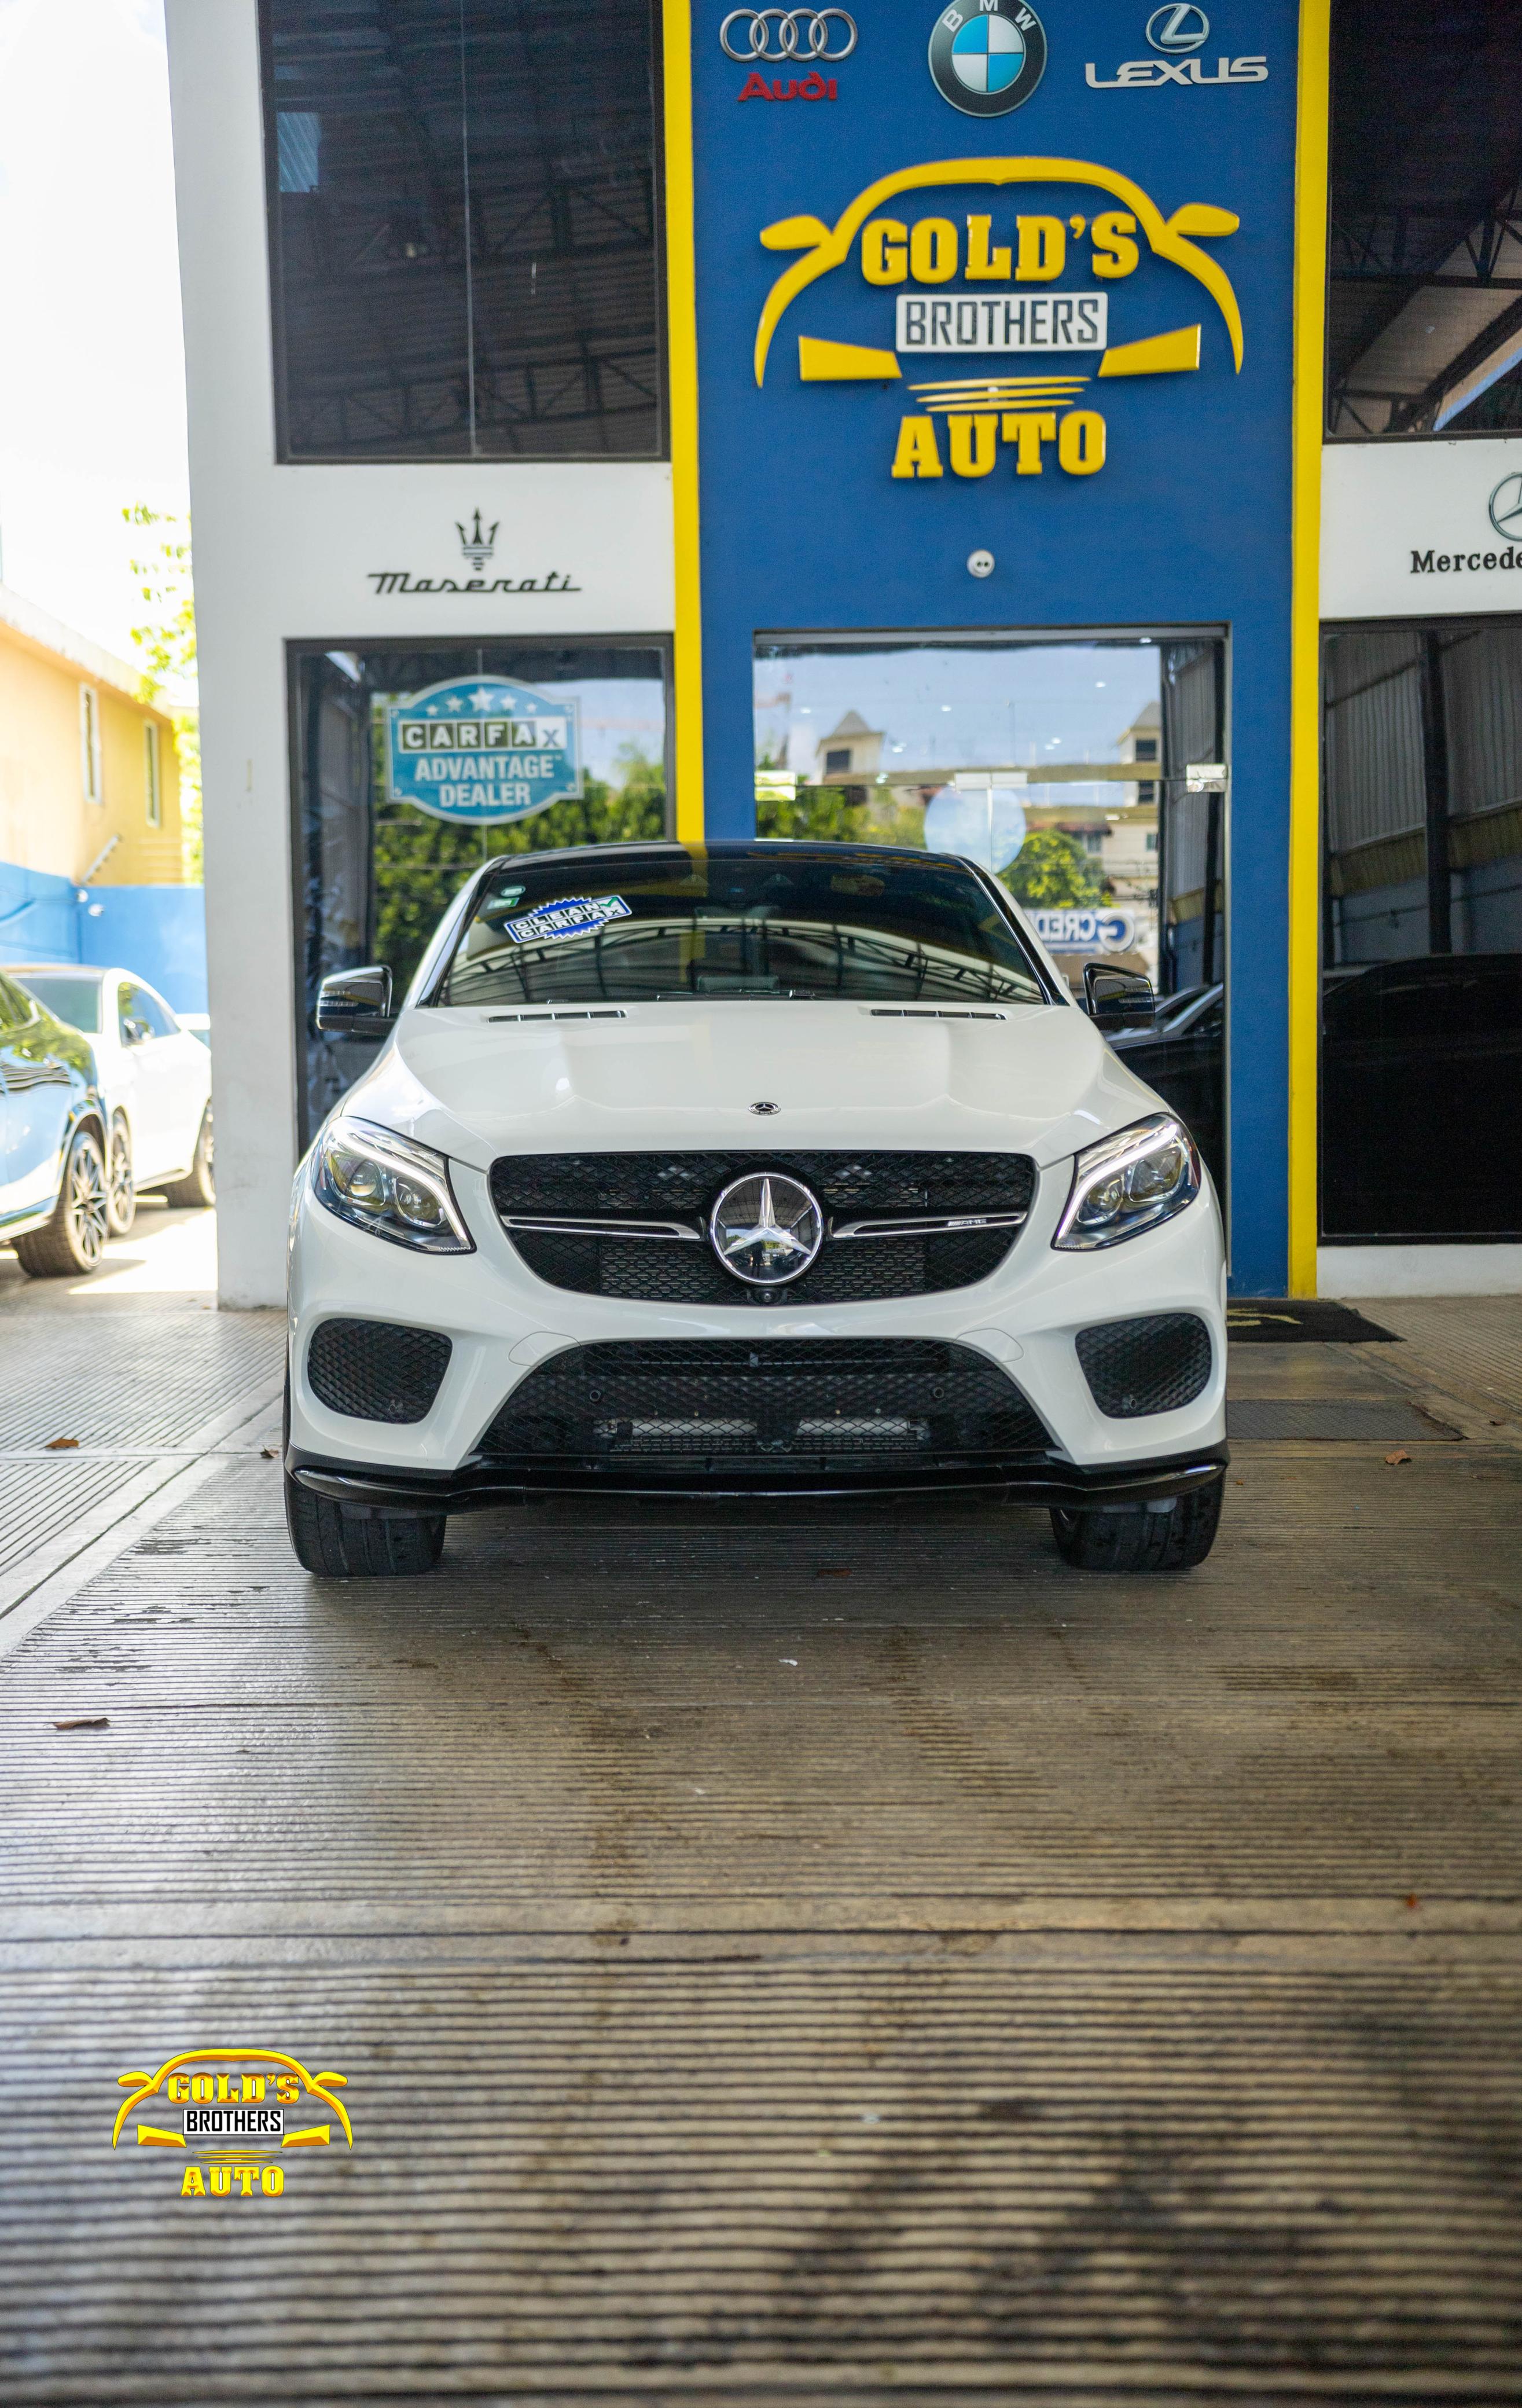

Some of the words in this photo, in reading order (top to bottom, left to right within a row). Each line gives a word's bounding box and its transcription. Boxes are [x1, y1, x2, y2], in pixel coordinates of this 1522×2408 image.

[942, 0, 1037, 32] BMW
[738, 72, 838, 101] Audi
[1085, 56, 1269, 89] LEXUS
[861, 212, 1139, 285] GOLD'S
[905, 299, 1099, 347] BROTHERS
[891, 410, 1106, 478] AUTO
[367, 571, 582, 594] Maserati
[406, 724, 560, 749] CARFAX
[414, 755, 554, 782] ADVANTAGE
[440, 783, 531, 807] DEALER
[515, 904, 600, 930] CLEAN
[521, 908, 621, 938] CARFAX
